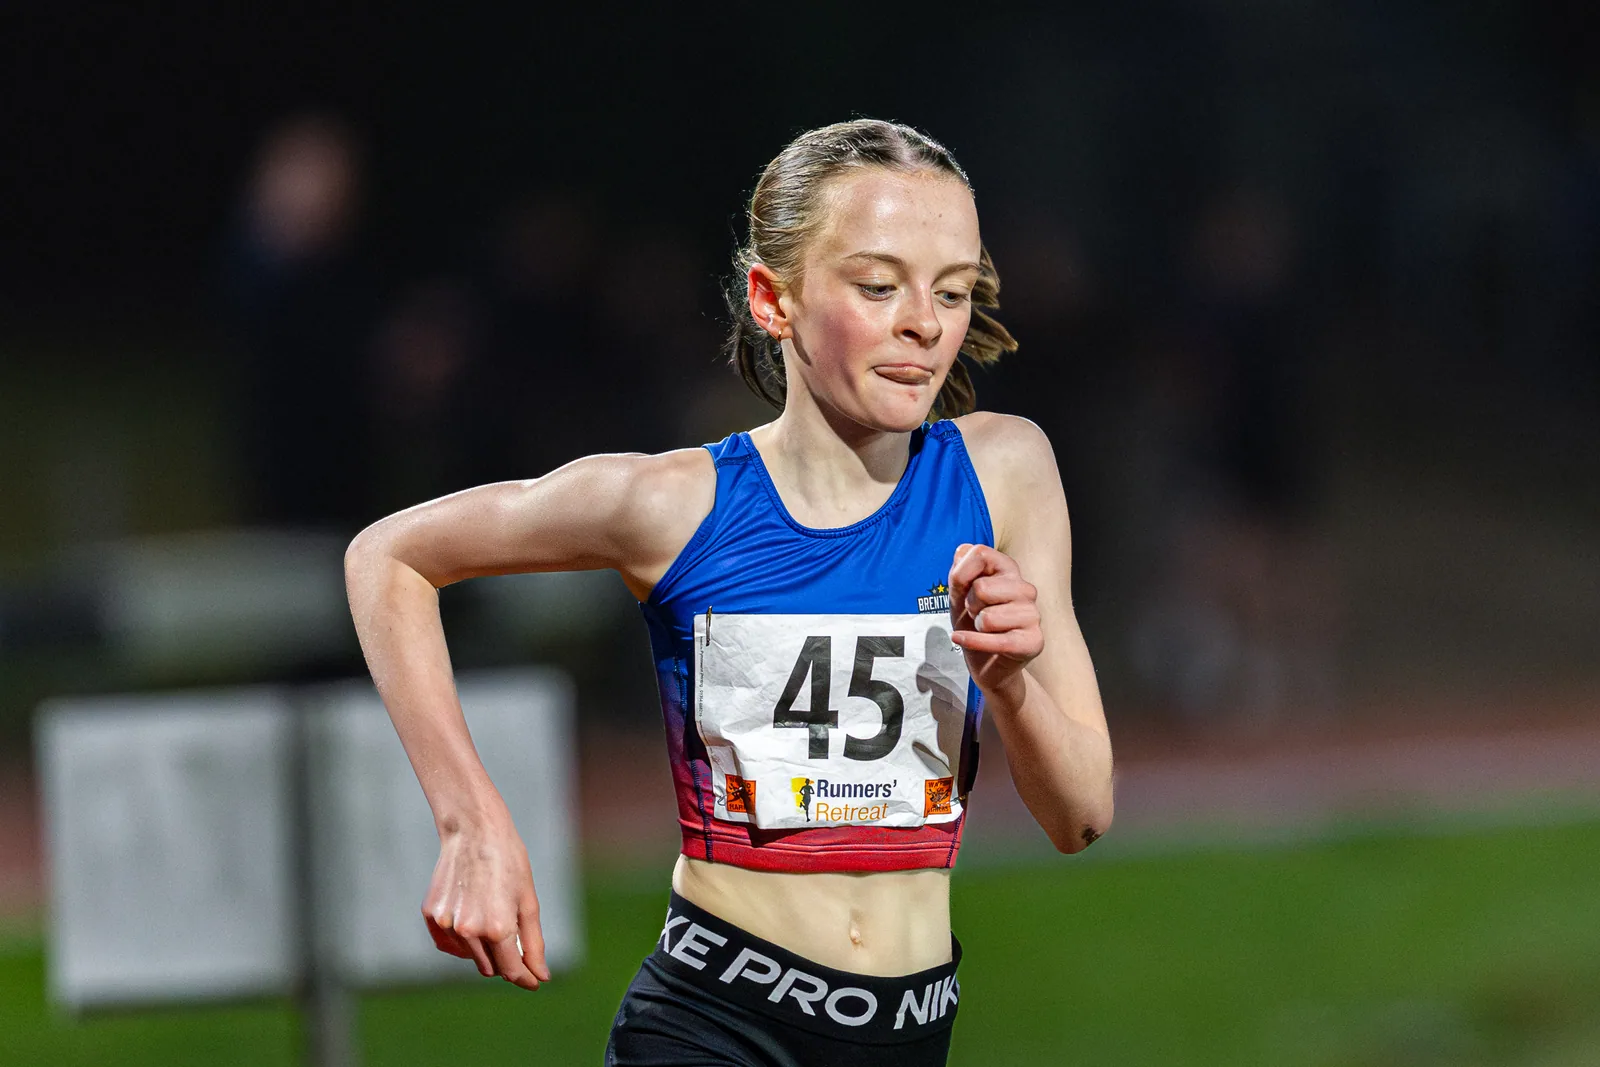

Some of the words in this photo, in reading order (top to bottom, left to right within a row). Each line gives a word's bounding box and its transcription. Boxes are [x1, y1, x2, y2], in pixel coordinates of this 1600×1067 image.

[917, 594, 950, 612] BRENTW
[773, 636, 905, 761] 45
[816, 779, 897, 798] Runners'
[816, 803, 889, 822] Retreat
[657, 907, 729, 971] KE
[719, 948, 878, 1026] PRO
[893, 973, 960, 1030] NIK
